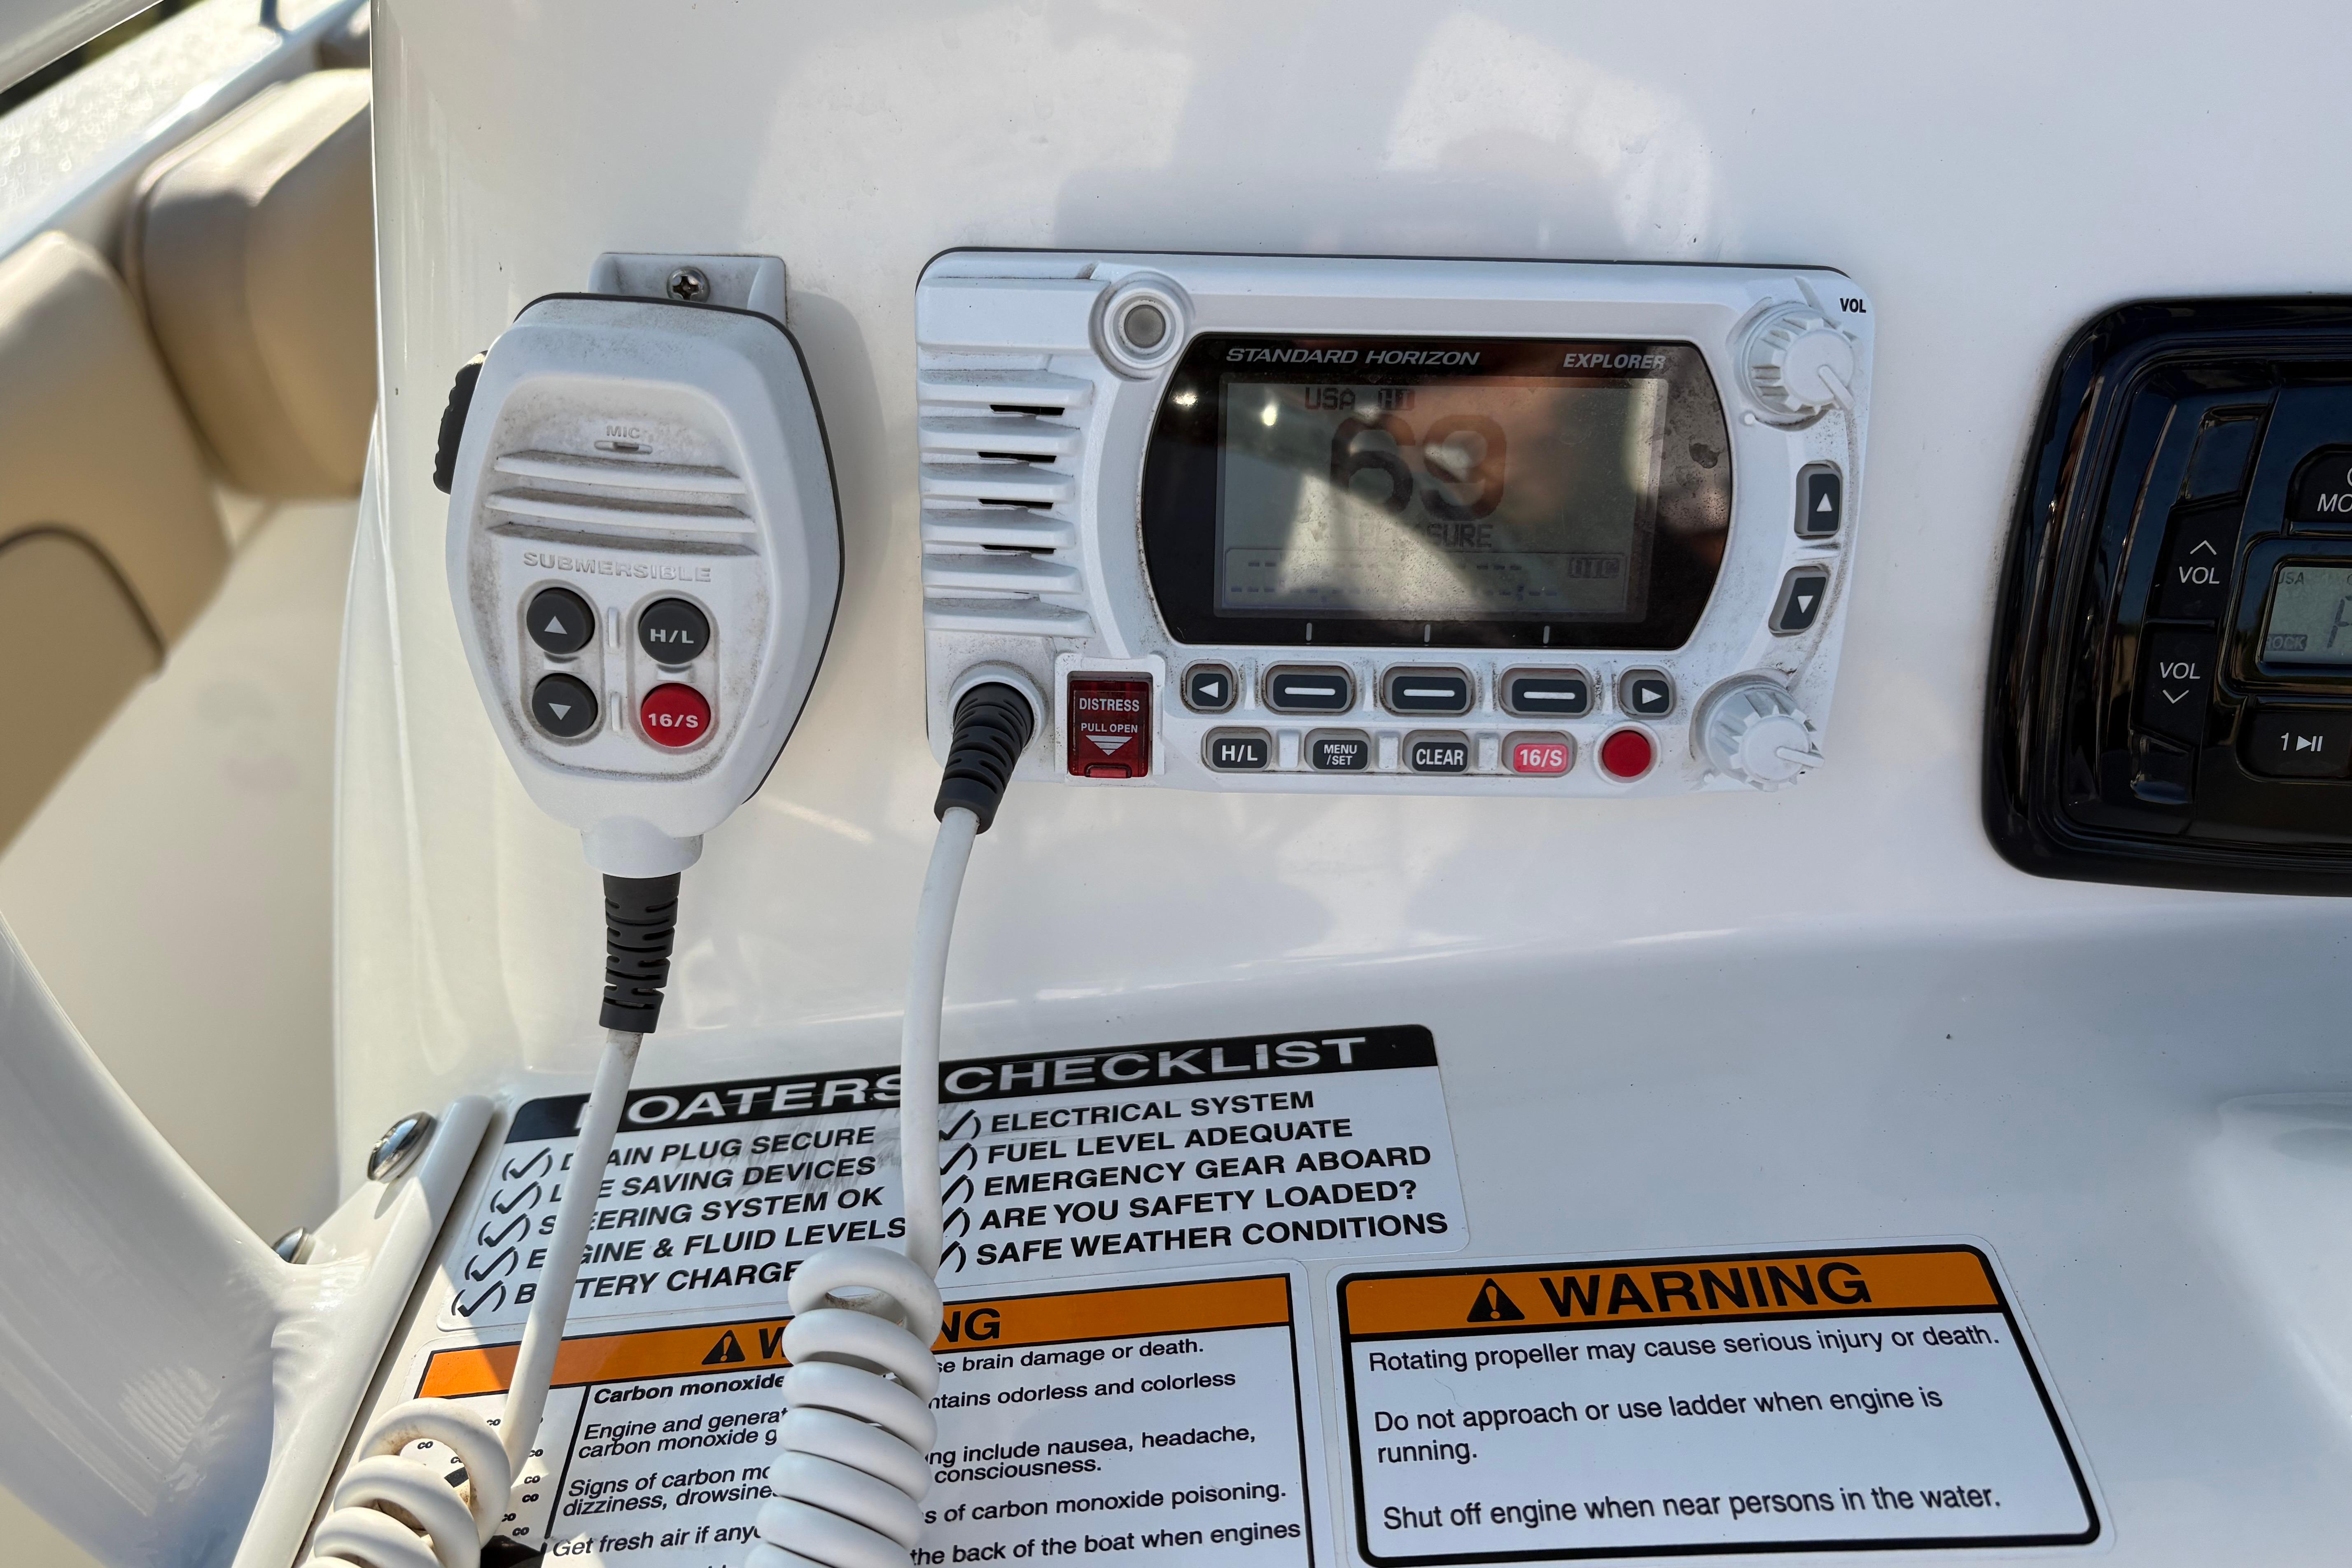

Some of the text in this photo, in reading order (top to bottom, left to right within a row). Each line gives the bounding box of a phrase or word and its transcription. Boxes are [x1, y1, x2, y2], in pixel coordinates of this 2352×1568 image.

[1840, 298, 1866, 313] VOL
[1227, 348, 1480, 365] STANDARD HORIZON
[1563, 354, 1666, 369] EXPLORER
[1304, 387, 1356, 410] USA
[606, 425, 642, 440] MIC
[1330, 414, 1507, 520] 69
[1358, 521, 1493, 548] PLSURE
[523, 551, 712, 583] SUBMERSIBLE
[2179, 567, 2219, 584] VOL
[651, 629, 693, 643] H/L
[2160, 662, 2200, 679] VOL
[649, 714, 698, 728] 16/S
[1080, 698, 1139, 712] DISTRESS
[1081, 723, 1137, 733] PULL OPEN
[2280, 732, 2289, 750] 1
[1222, 745, 1258, 762] H/L
[1324, 744, 1357, 754] MENU
[1327, 755, 1352, 765] /SET
[1416, 749, 1463, 765] CLEAR
[1520, 749, 1562, 767] 16/S
[574, 1037, 1366, 1129] OATERS CHECKLIST
[992, 1091, 1313, 1132] ELECTRICAL SYSTEM
[560, 1126, 875, 1171] DAIN PLUG SECURE
[988, 1119, 1352, 1163] FUEL LEVEL ADEQUATE
[550, 1157, 875, 1202] LE SAVING DEVICES
[985, 1146, 1430, 1196] EMERGENCY GEAR ABOARD
[539, 1187, 884, 1234] SERING SYSTEM OK
[980, 1180, 1416, 1230] ARE YOU SAFETY LOADED?
[527, 1218, 905, 1269] EGINE & FLUID LEVELS
[977, 1213, 1447, 1265] SAFE WEATHER CONDITIONS
[514, 1260, 804, 1304] BTERY CHARGE
[1539, 1262, 1871, 1317] WARNING
[963, 1354, 1013, 1371] brain
[1021, 1349, 1105, 1366] damage
[1112, 1346, 1133, 1358] or
[1139, 1339, 1203, 1356] death.
[1370, 1325, 1999, 1372] Rotating propeller may cause serious injury or death.
[594, 1373, 784, 1404] Carbon monoxide
[929, 1373, 1235, 1409] ntains odorless and colorless
[584, 1408, 788, 1440] Engine and generat
[1375, 1387, 1942, 1431] Do not approach or use ladder when engine is
[579, 1441, 650, 1458] carbon
[658, 1428, 758, 1451] monoxide
[964, 1441, 1040, 1465] include
[1048, 1437, 1132, 1455] nausea,
[1142, 1426, 1255, 1447] headache,
[1378, 1440, 1477, 1464] running.
[569, 1479, 628, 1502] Signs
[635, 1472, 657, 1490] of
[662, 1469, 735, 1488] carbon
[934, 1457, 1101, 1484] consciousness.
[563, 1484, 778, 1516] dizziness, drowsine
[944, 1504, 966, 1522] of
[972, 1500, 1047, 1519] carbon
[1057, 1490, 1163, 1513] monoxide
[1172, 1482, 1286, 1509] poisoning.
[1384, 1486, 2000, 1529] Shut off engine when near persons in the water.
[553, 1526, 761, 1556] Get fresh air if any
[953, 1542, 1006, 1562] back
[1013, 1539, 1035, 1557] of
[1041, 1538, 1076, 1556] the
[1085, 1533, 1134, 1552] boat
[1141, 1529, 1202, 1547] when
[1211, 1522, 1300, 1545] engines
